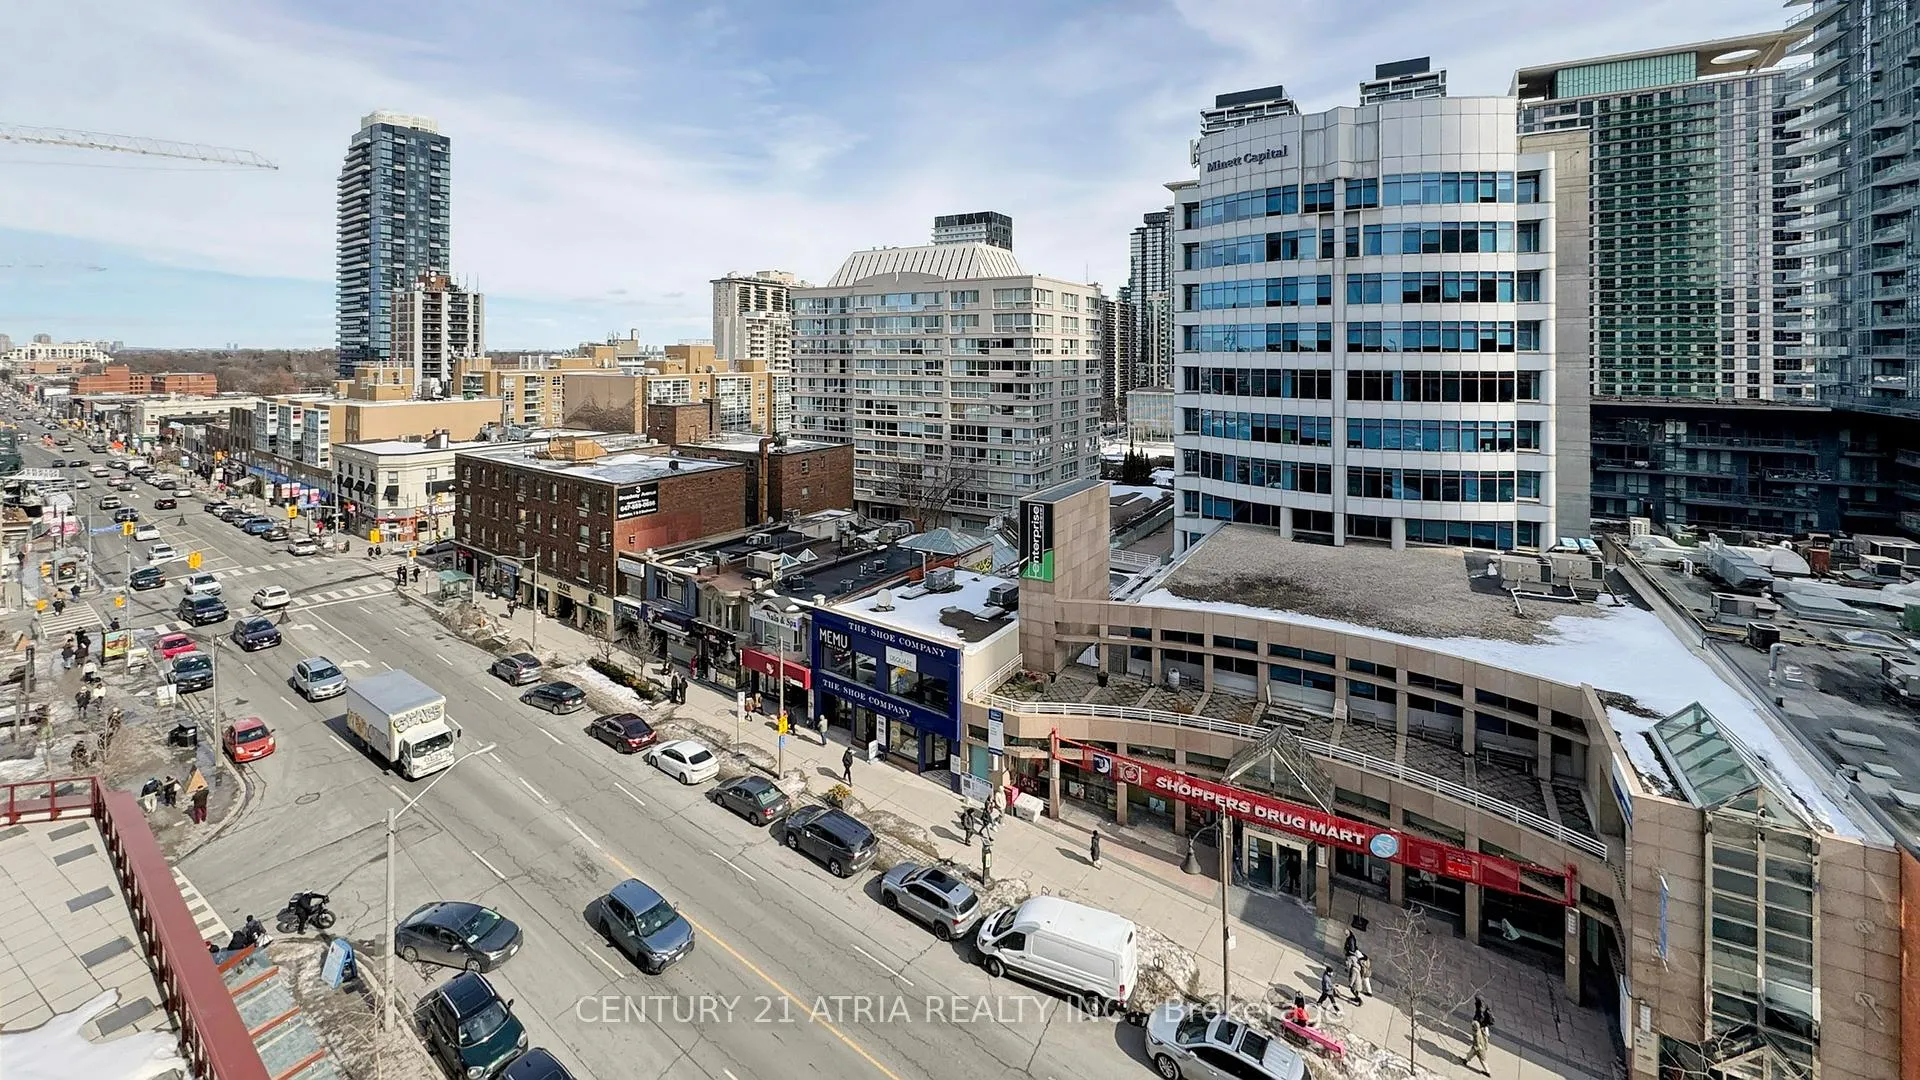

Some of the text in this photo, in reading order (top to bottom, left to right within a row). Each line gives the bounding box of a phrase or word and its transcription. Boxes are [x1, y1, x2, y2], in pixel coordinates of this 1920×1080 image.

[1207, 145, 1288, 173] Minett Capital
[635, 485, 641, 494] 3
[1031, 506, 1042, 573] enterprise
[786, 618, 797, 629] Spa
[819, 627, 848, 649] MEMU
[848, 622, 947, 658] THE SHOE COMPANY
[822, 678, 912, 718] THE SHOE COMPANY
[1155, 776, 1366, 846] SHOPPERS DRUG MART
